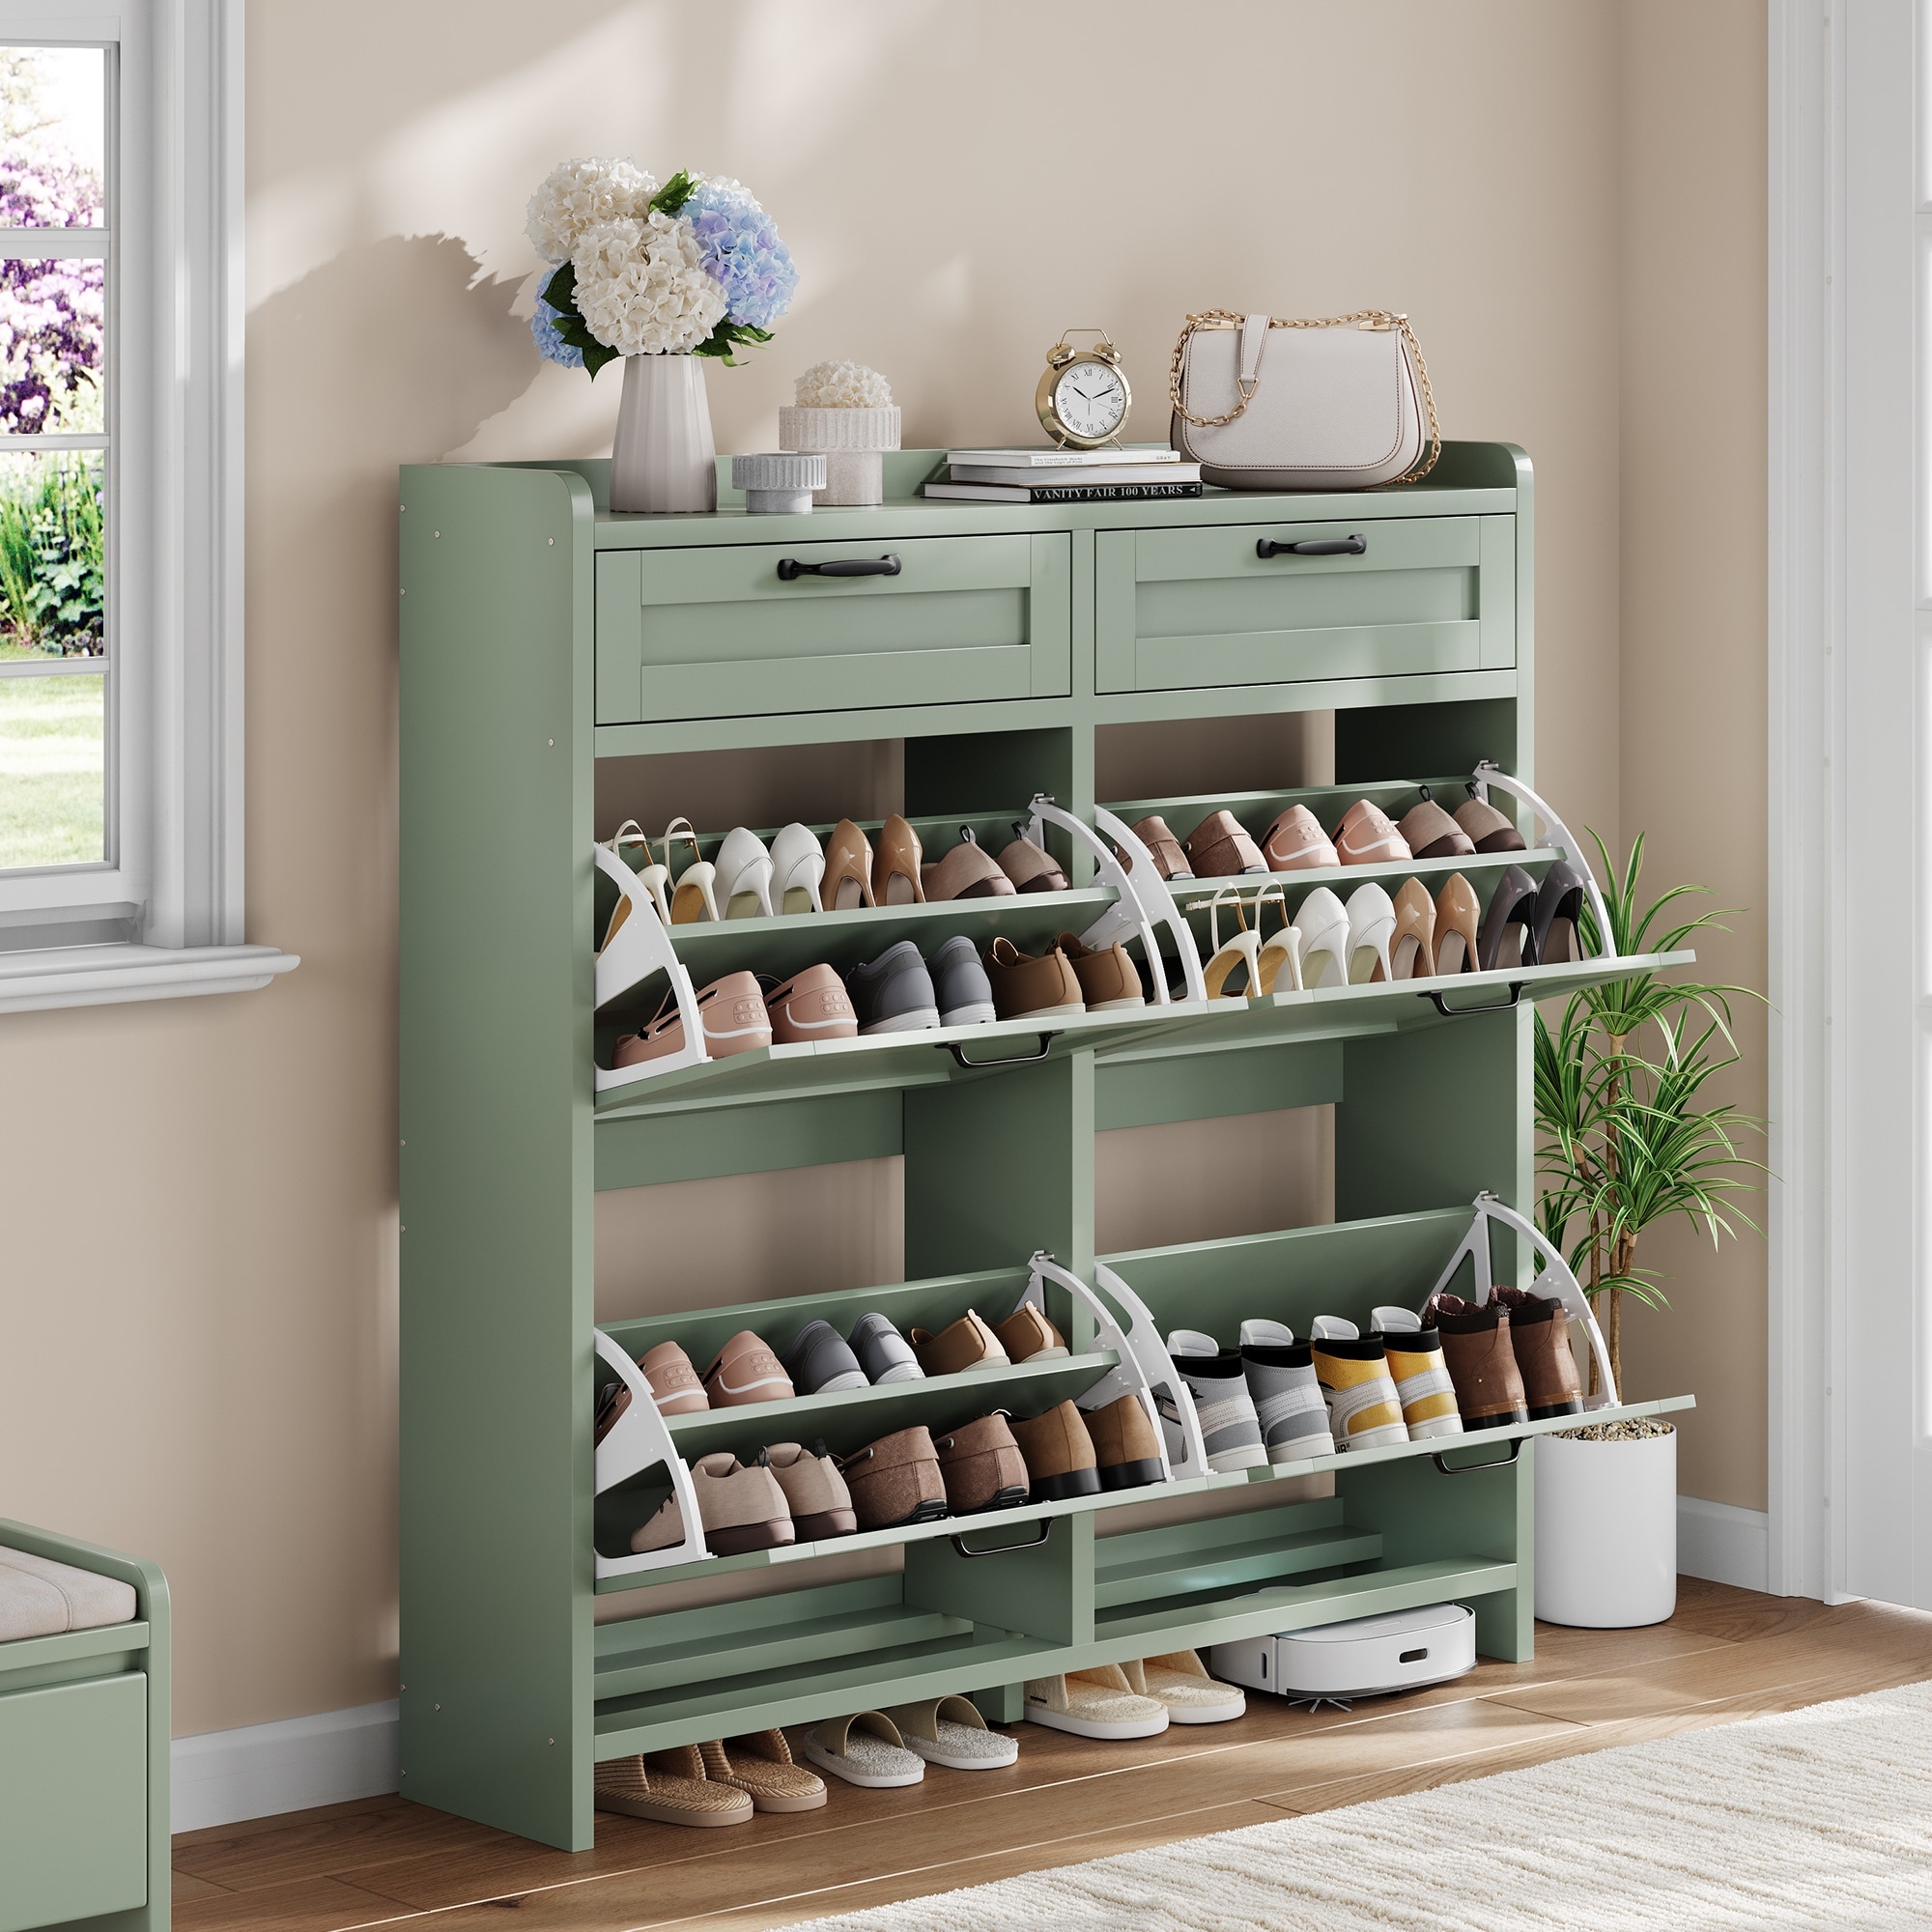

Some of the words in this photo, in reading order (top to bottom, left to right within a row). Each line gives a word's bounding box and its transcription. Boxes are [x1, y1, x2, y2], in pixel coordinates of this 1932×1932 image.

[1084, 368, 1093, 377] XII
[1034, 487, 1083, 499] VANITY
[1087, 486, 1117, 497] FAIR
[1121, 486, 1139, 497] 100
[1142, 485, 1183, 497] YEARS
